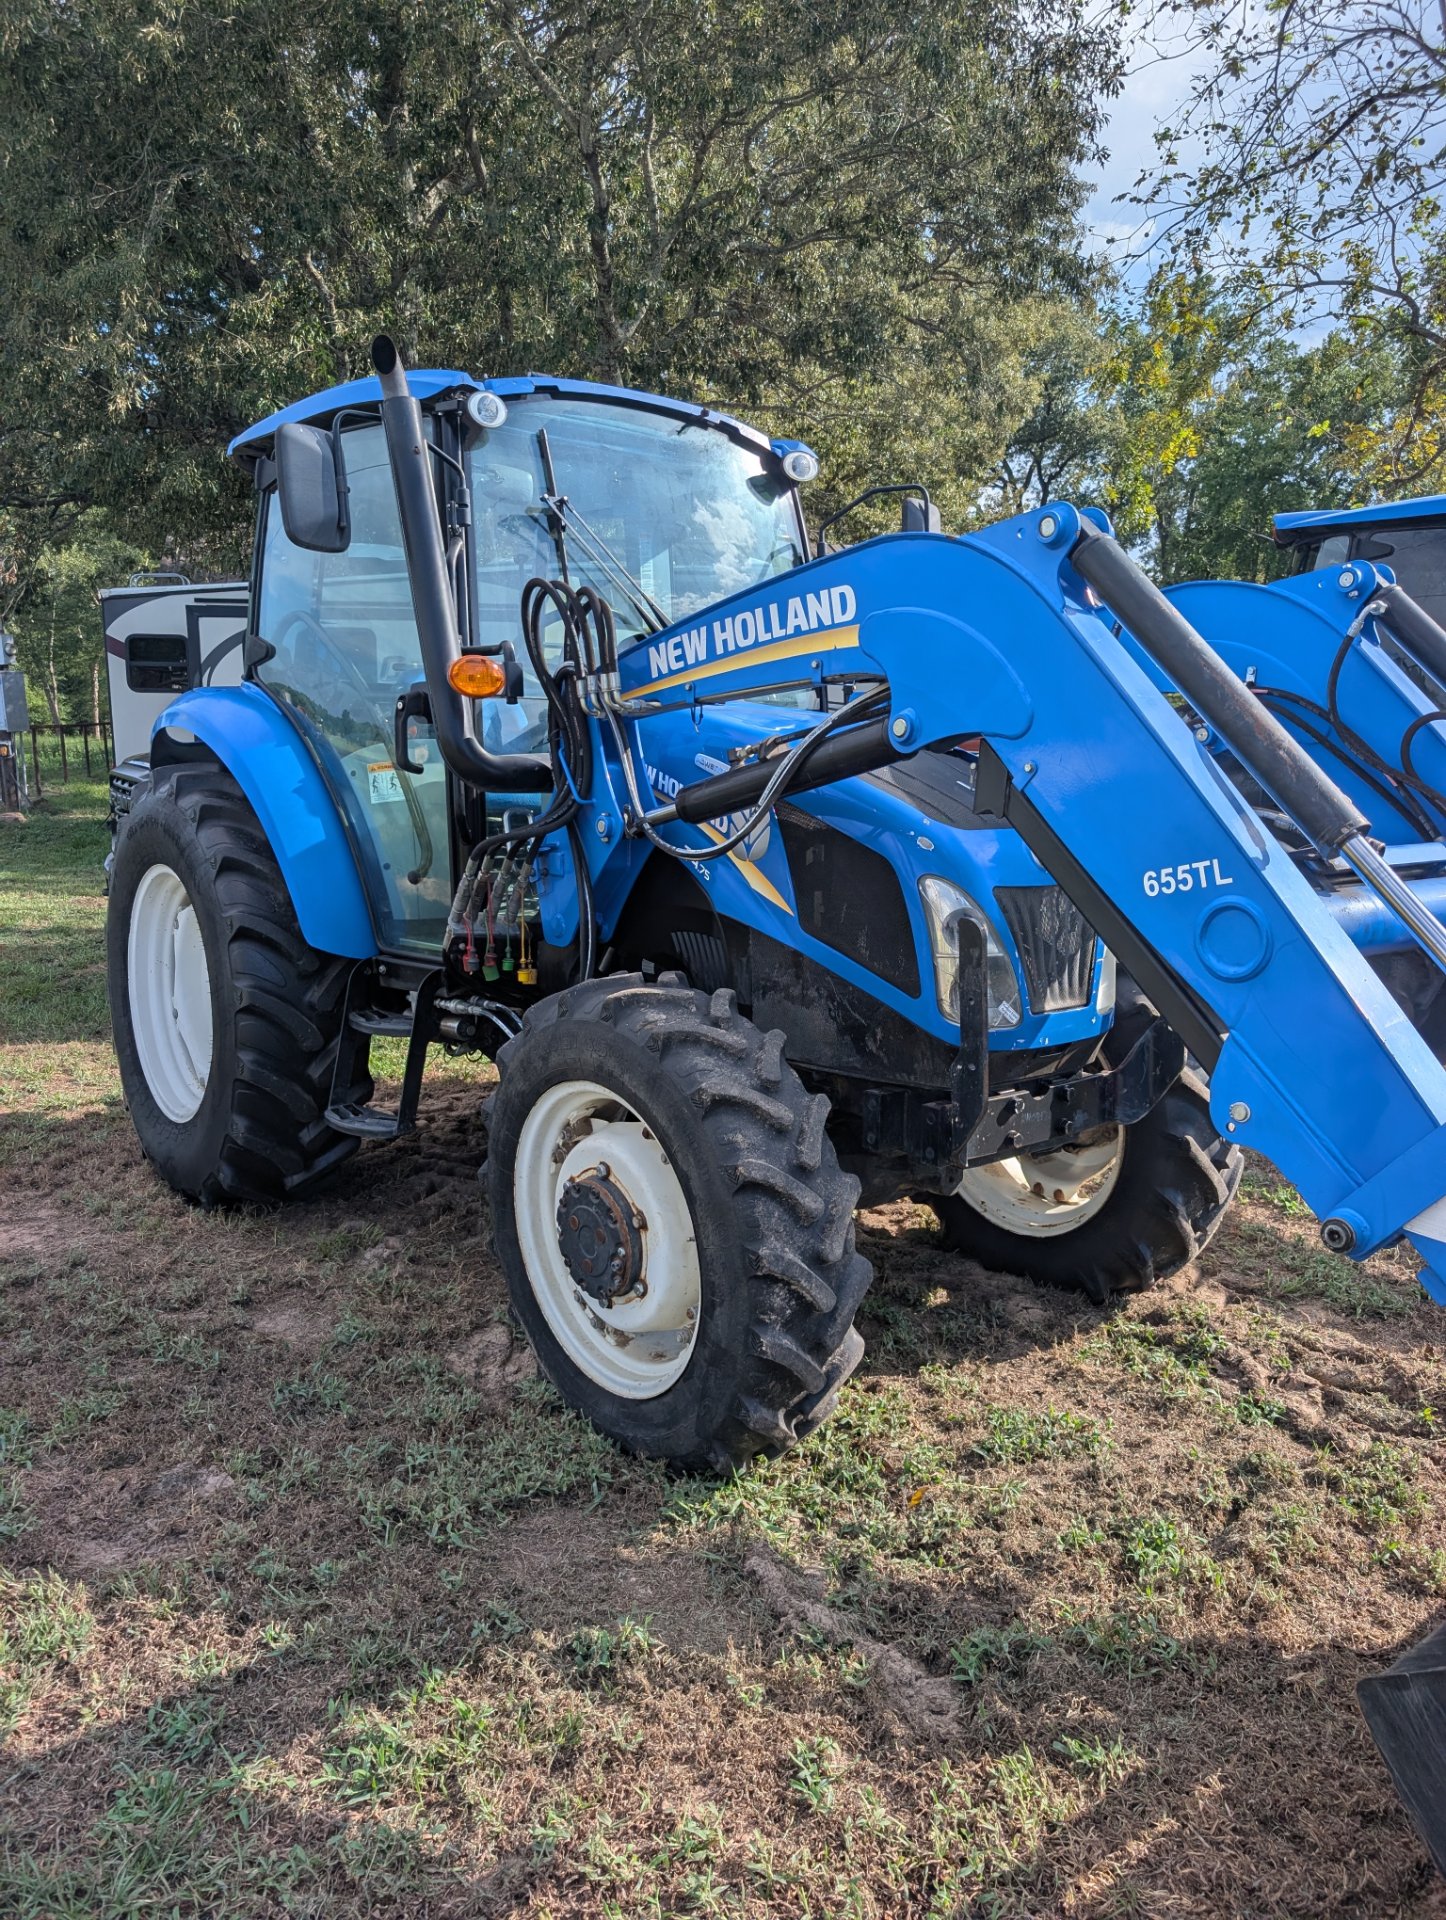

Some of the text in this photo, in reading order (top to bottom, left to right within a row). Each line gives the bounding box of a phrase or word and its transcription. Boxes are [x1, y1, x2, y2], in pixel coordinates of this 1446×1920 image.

[648, 584, 857, 679] NEW HOLLAND
[1143, 858, 1233, 897] 655TL
